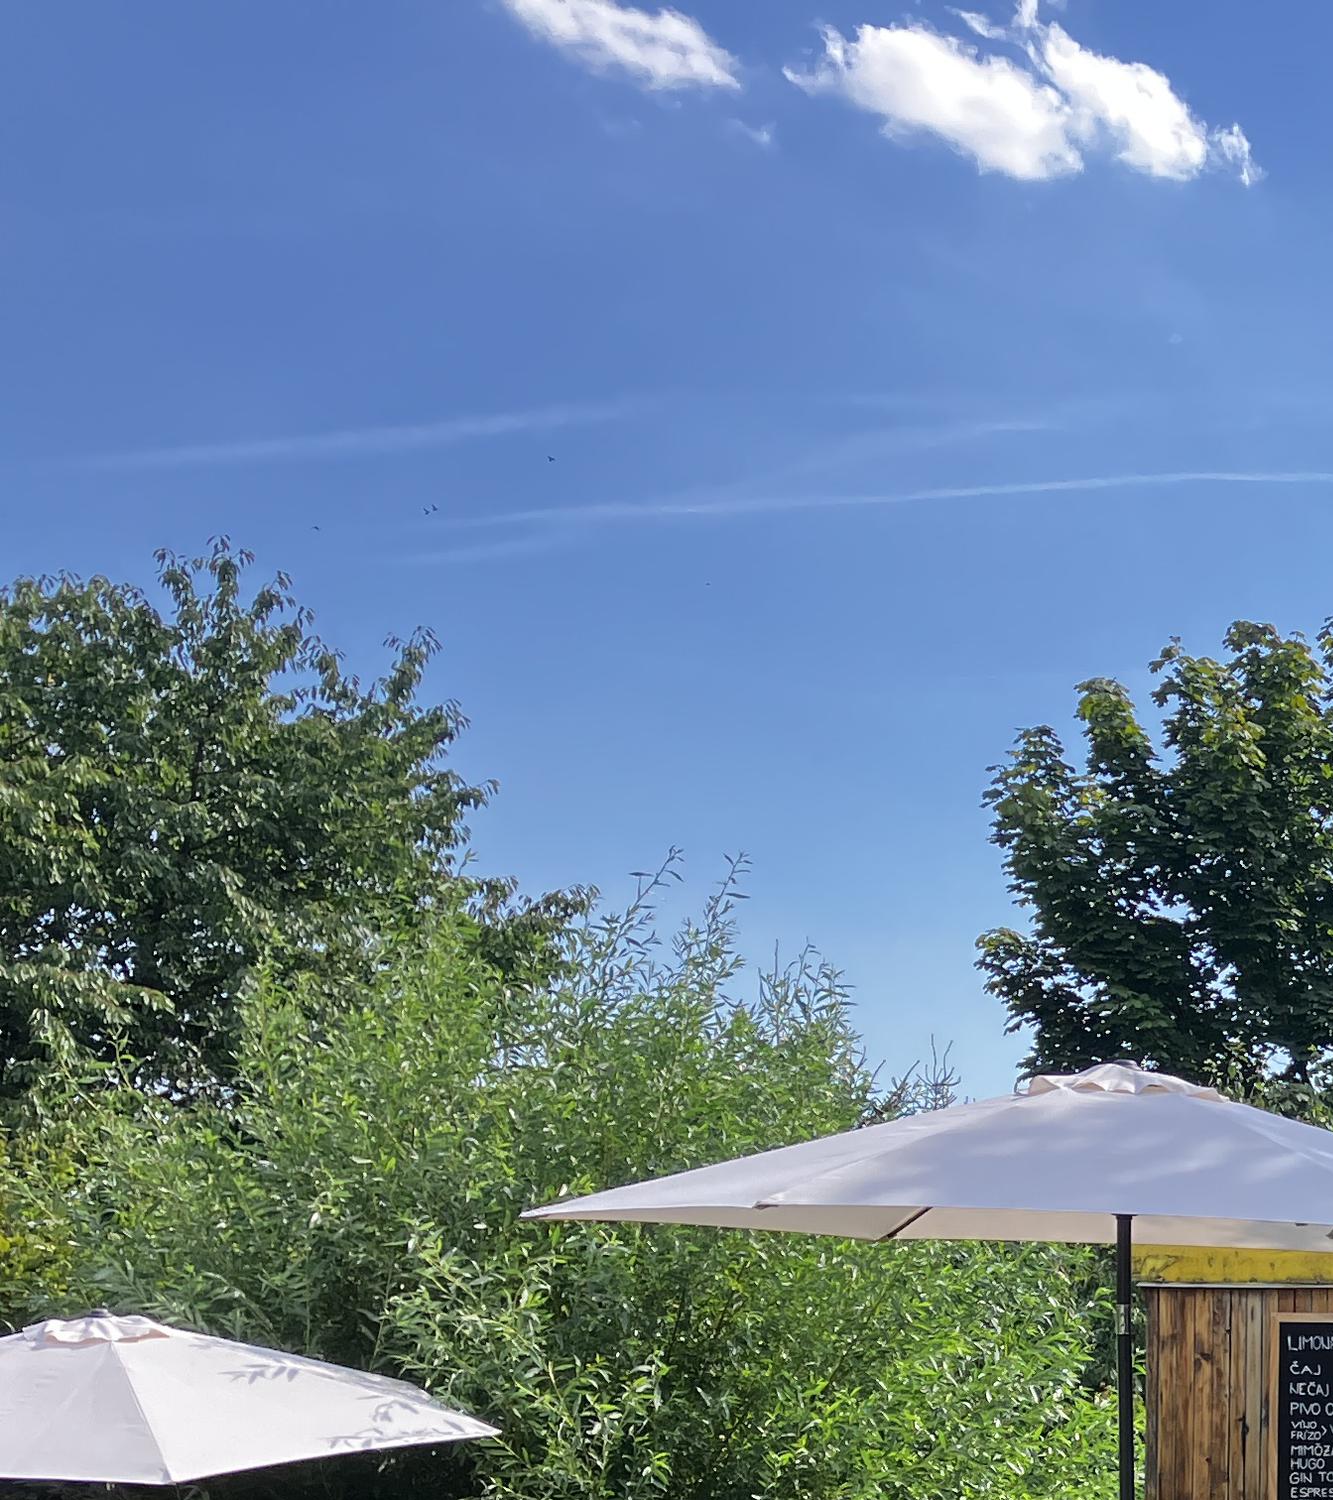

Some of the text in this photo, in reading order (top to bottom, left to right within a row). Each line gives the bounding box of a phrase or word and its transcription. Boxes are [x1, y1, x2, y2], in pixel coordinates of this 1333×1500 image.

[1289, 1360, 1321, 1376] ČAJ
[1289, 1381, 1330, 1397] NEČAJ
[1290, 1402, 1321, 1416] PIVO
[1290, 1458, 1325, 1470] HUGO
[1289, 1472, 1313, 1484] GIN
